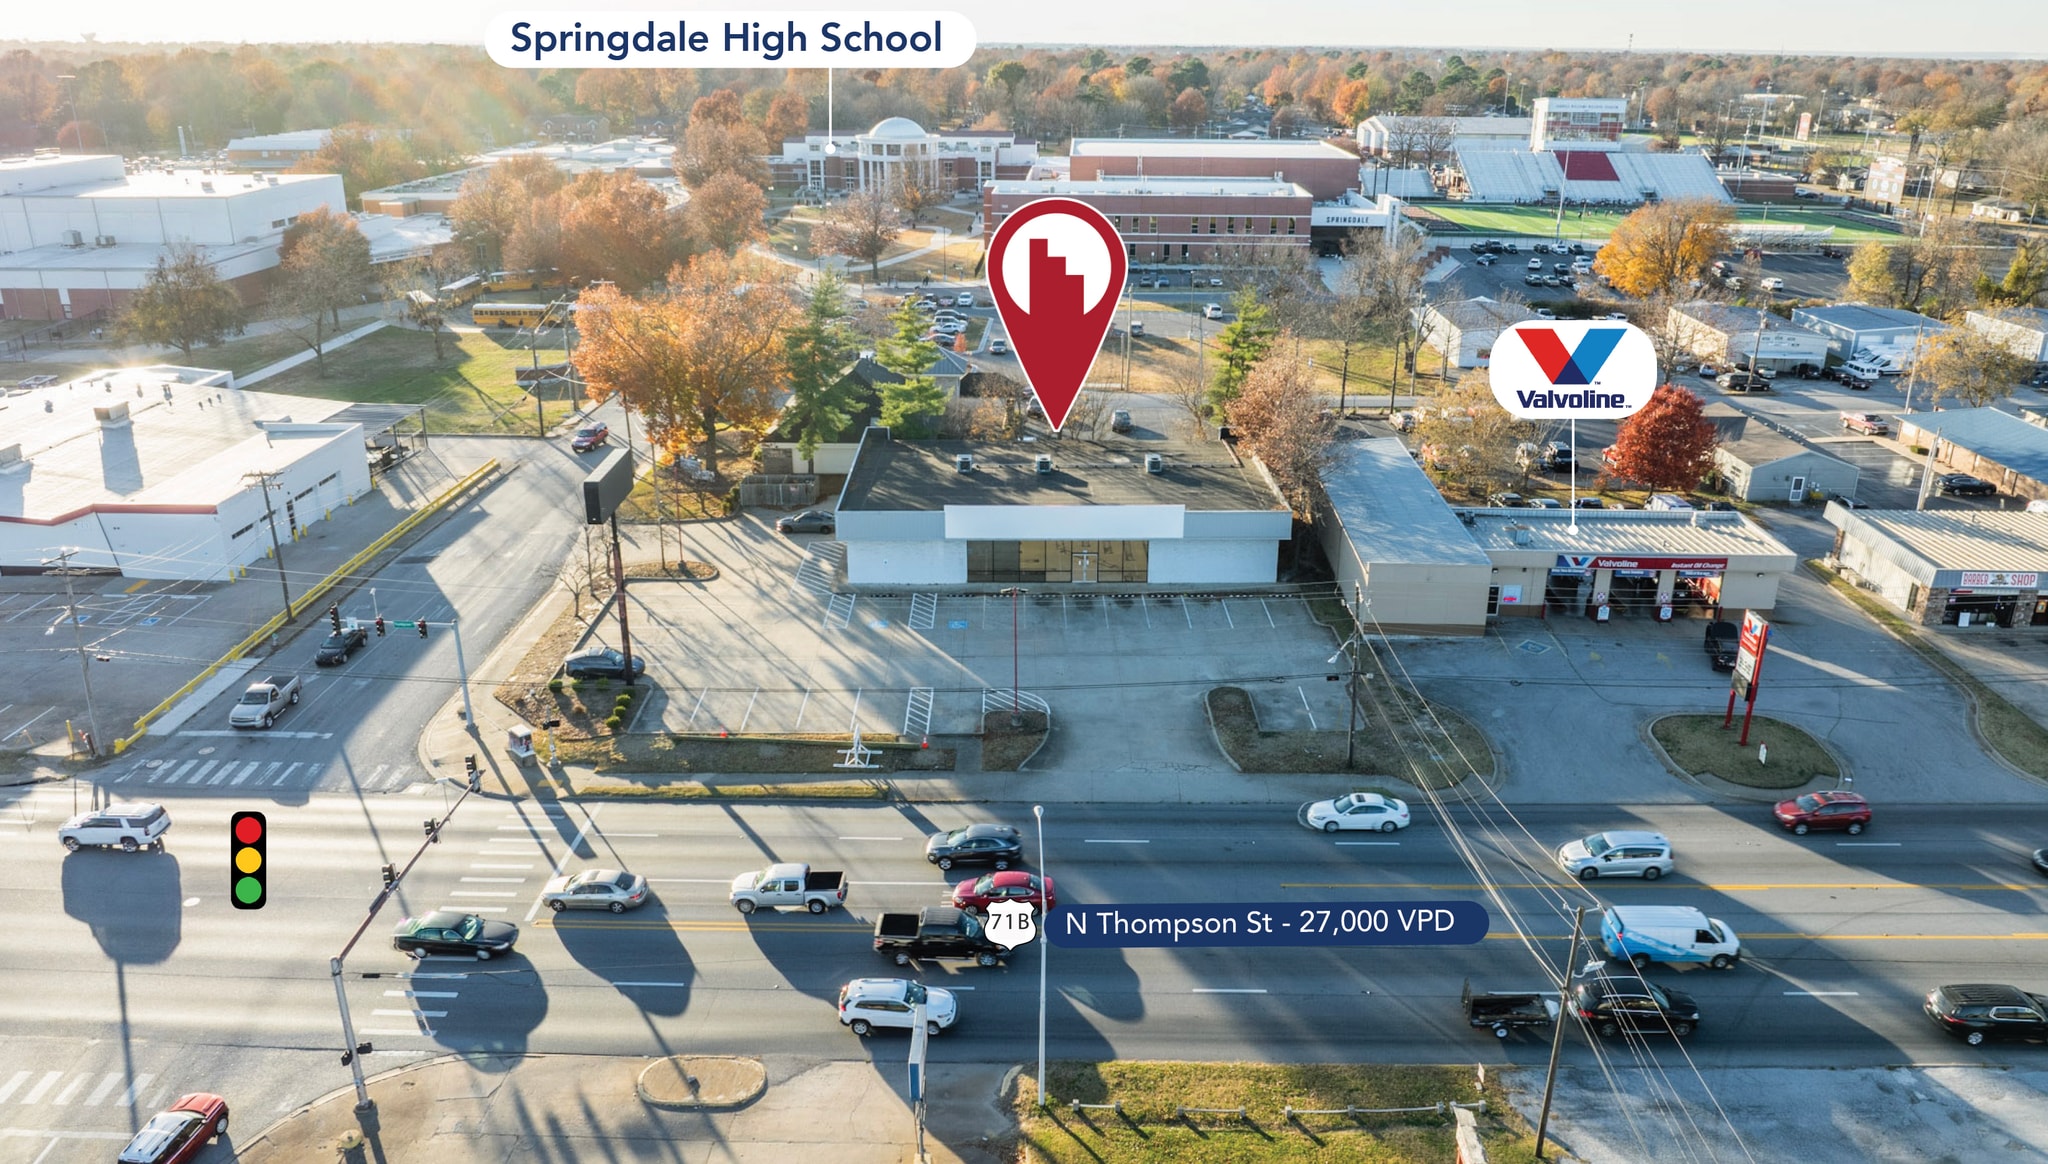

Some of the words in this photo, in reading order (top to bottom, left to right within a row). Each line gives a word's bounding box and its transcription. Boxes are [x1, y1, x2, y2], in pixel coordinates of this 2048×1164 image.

[1326, 216, 1369, 224] SPRINGDALE
[1597, 559, 1639, 568] Valvoline
[1963, 573, 1989, 585] BARBER
[2010, 574, 2036, 586] SHOP
